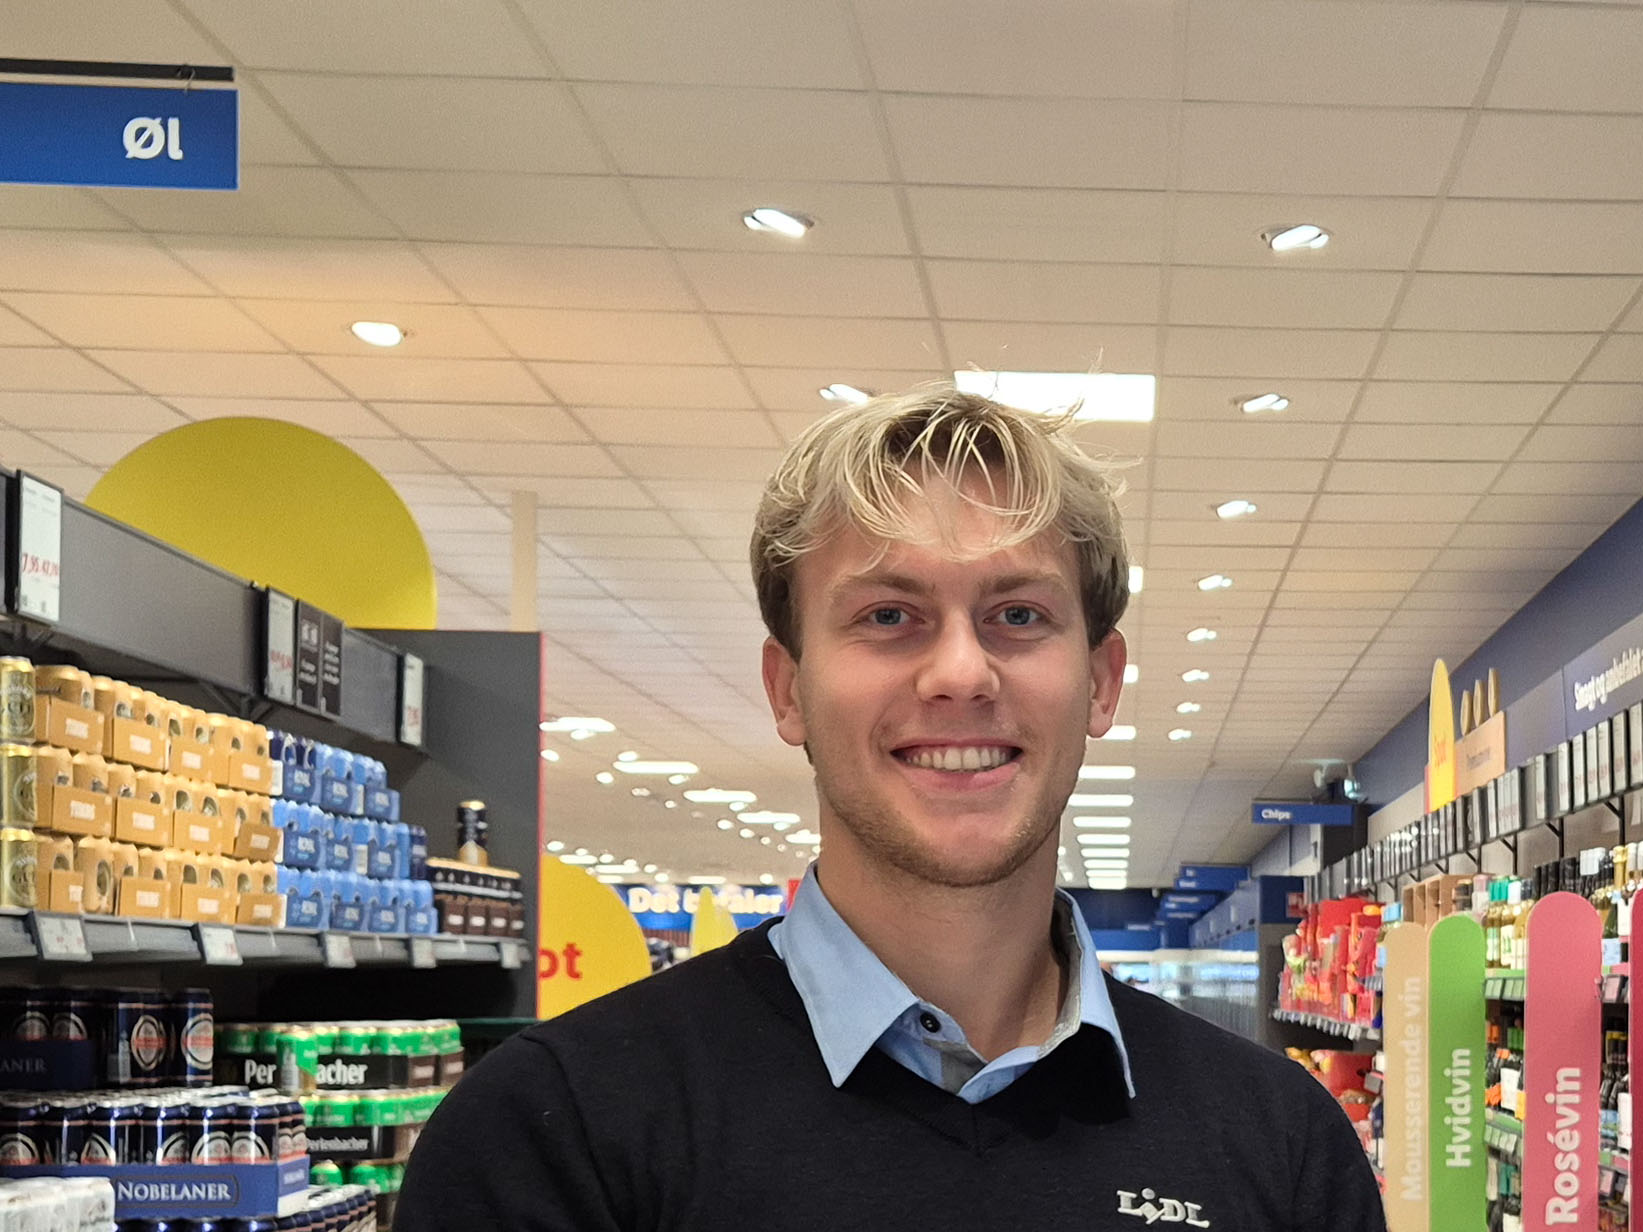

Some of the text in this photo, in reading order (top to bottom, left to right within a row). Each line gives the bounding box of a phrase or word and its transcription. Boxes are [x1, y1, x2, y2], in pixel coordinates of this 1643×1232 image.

[122, 116, 183, 160] Øl
[1261, 807, 1292, 822] Chips
[1398, 976, 1422, 1018] vin
[1446, 1048, 1471, 1168] Hvidvin
[1545, 1066, 1582, 1226] Rosévin
[117, 1181, 232, 1202] NOBELANER
